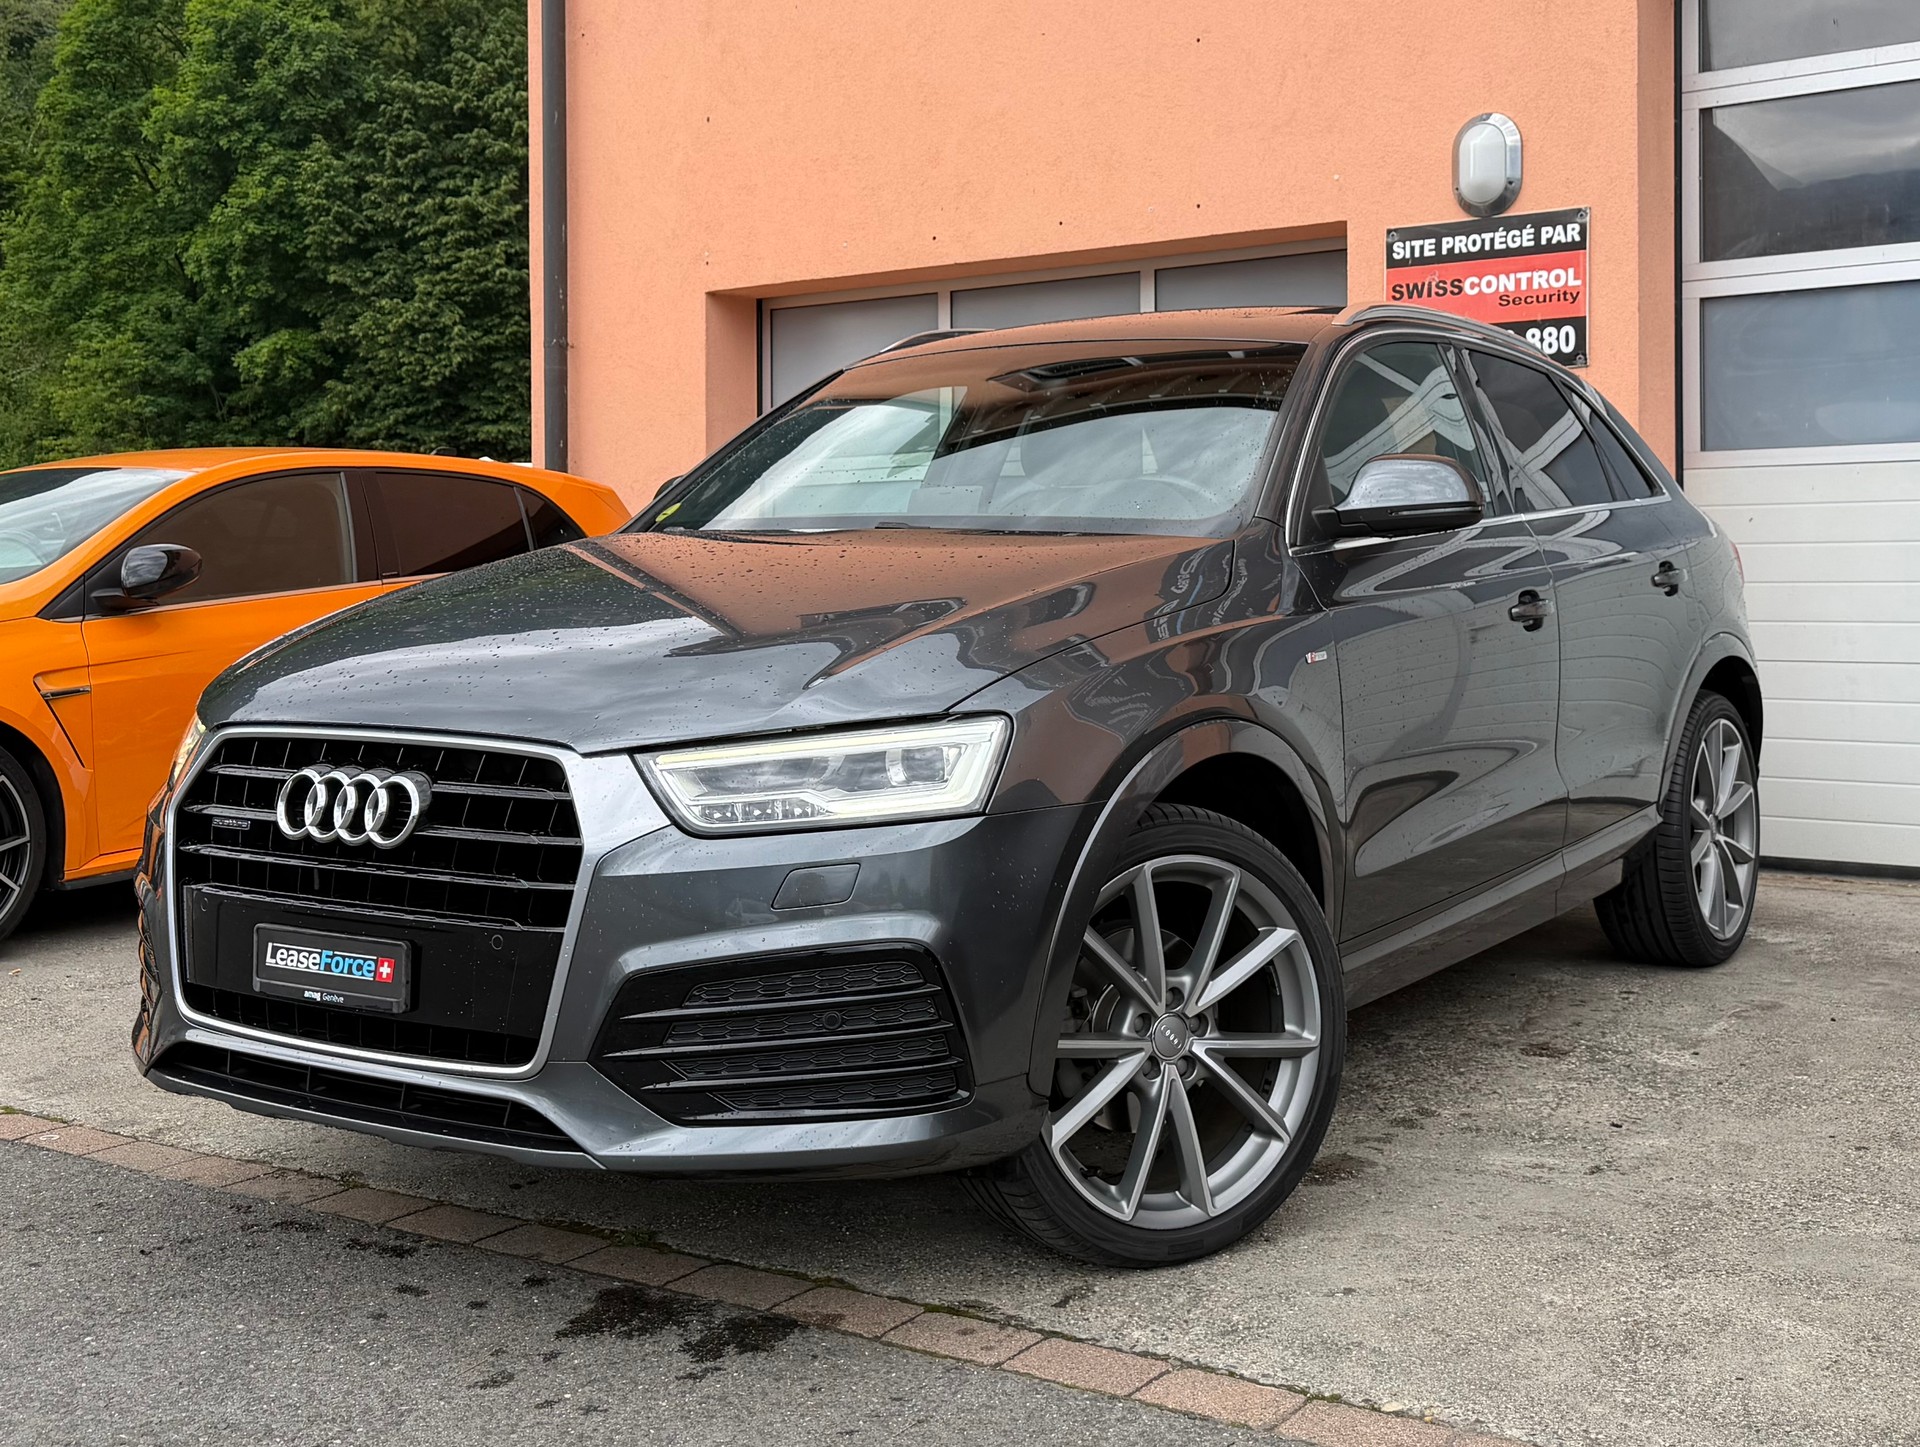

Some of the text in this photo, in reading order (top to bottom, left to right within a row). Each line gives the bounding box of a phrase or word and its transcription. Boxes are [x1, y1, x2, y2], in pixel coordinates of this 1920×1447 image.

[1392, 223, 1581, 260] SITE PROTÉGÉ PAR
[1498, 289, 1580, 307] Security
[265, 942, 376, 978] LeaseForce
